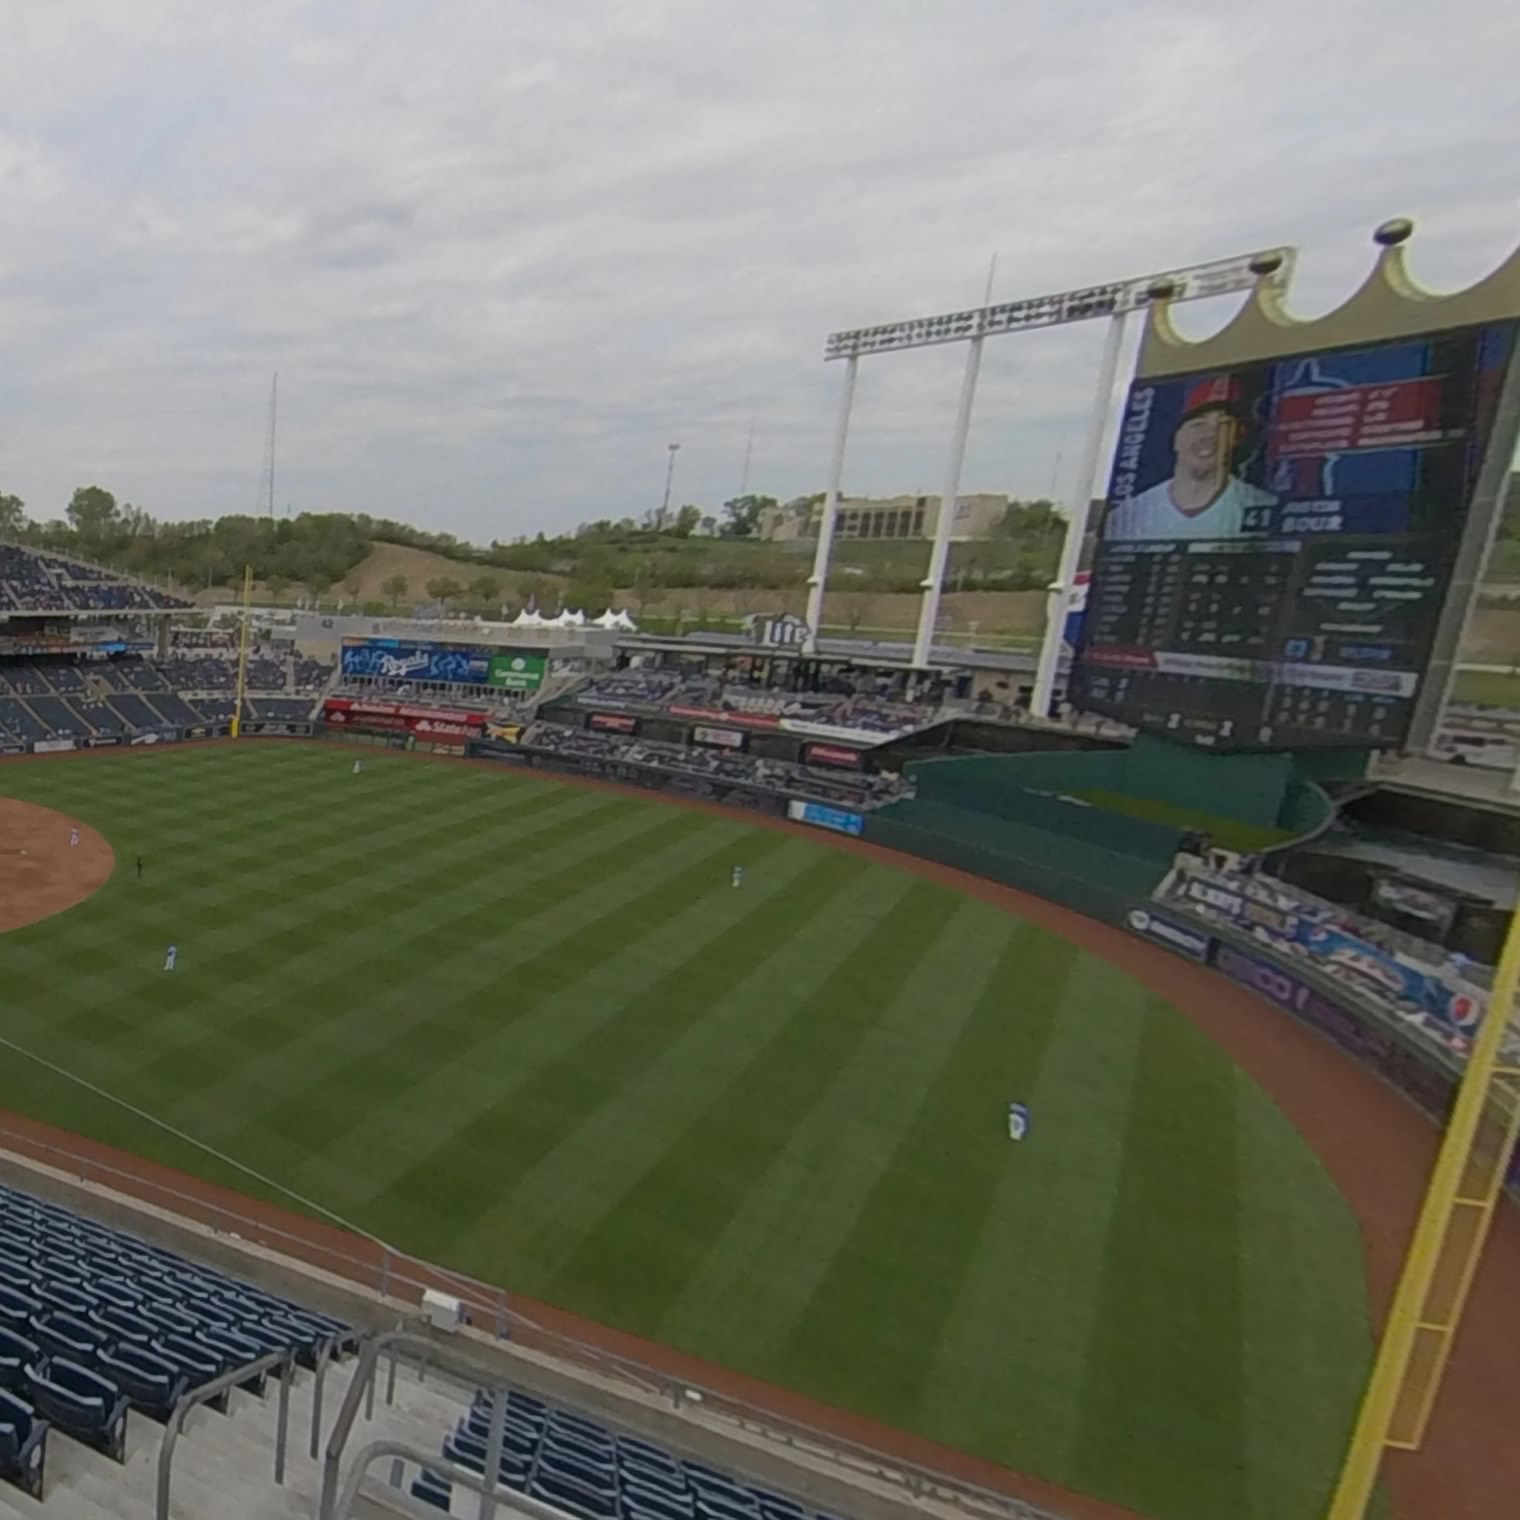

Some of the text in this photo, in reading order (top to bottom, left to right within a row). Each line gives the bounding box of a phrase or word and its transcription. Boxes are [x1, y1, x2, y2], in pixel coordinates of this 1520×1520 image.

[1119, 386, 1155, 470] ANGELES
[1244, 508, 1271, 527] 41
[380, 650, 429, 676] Royals
